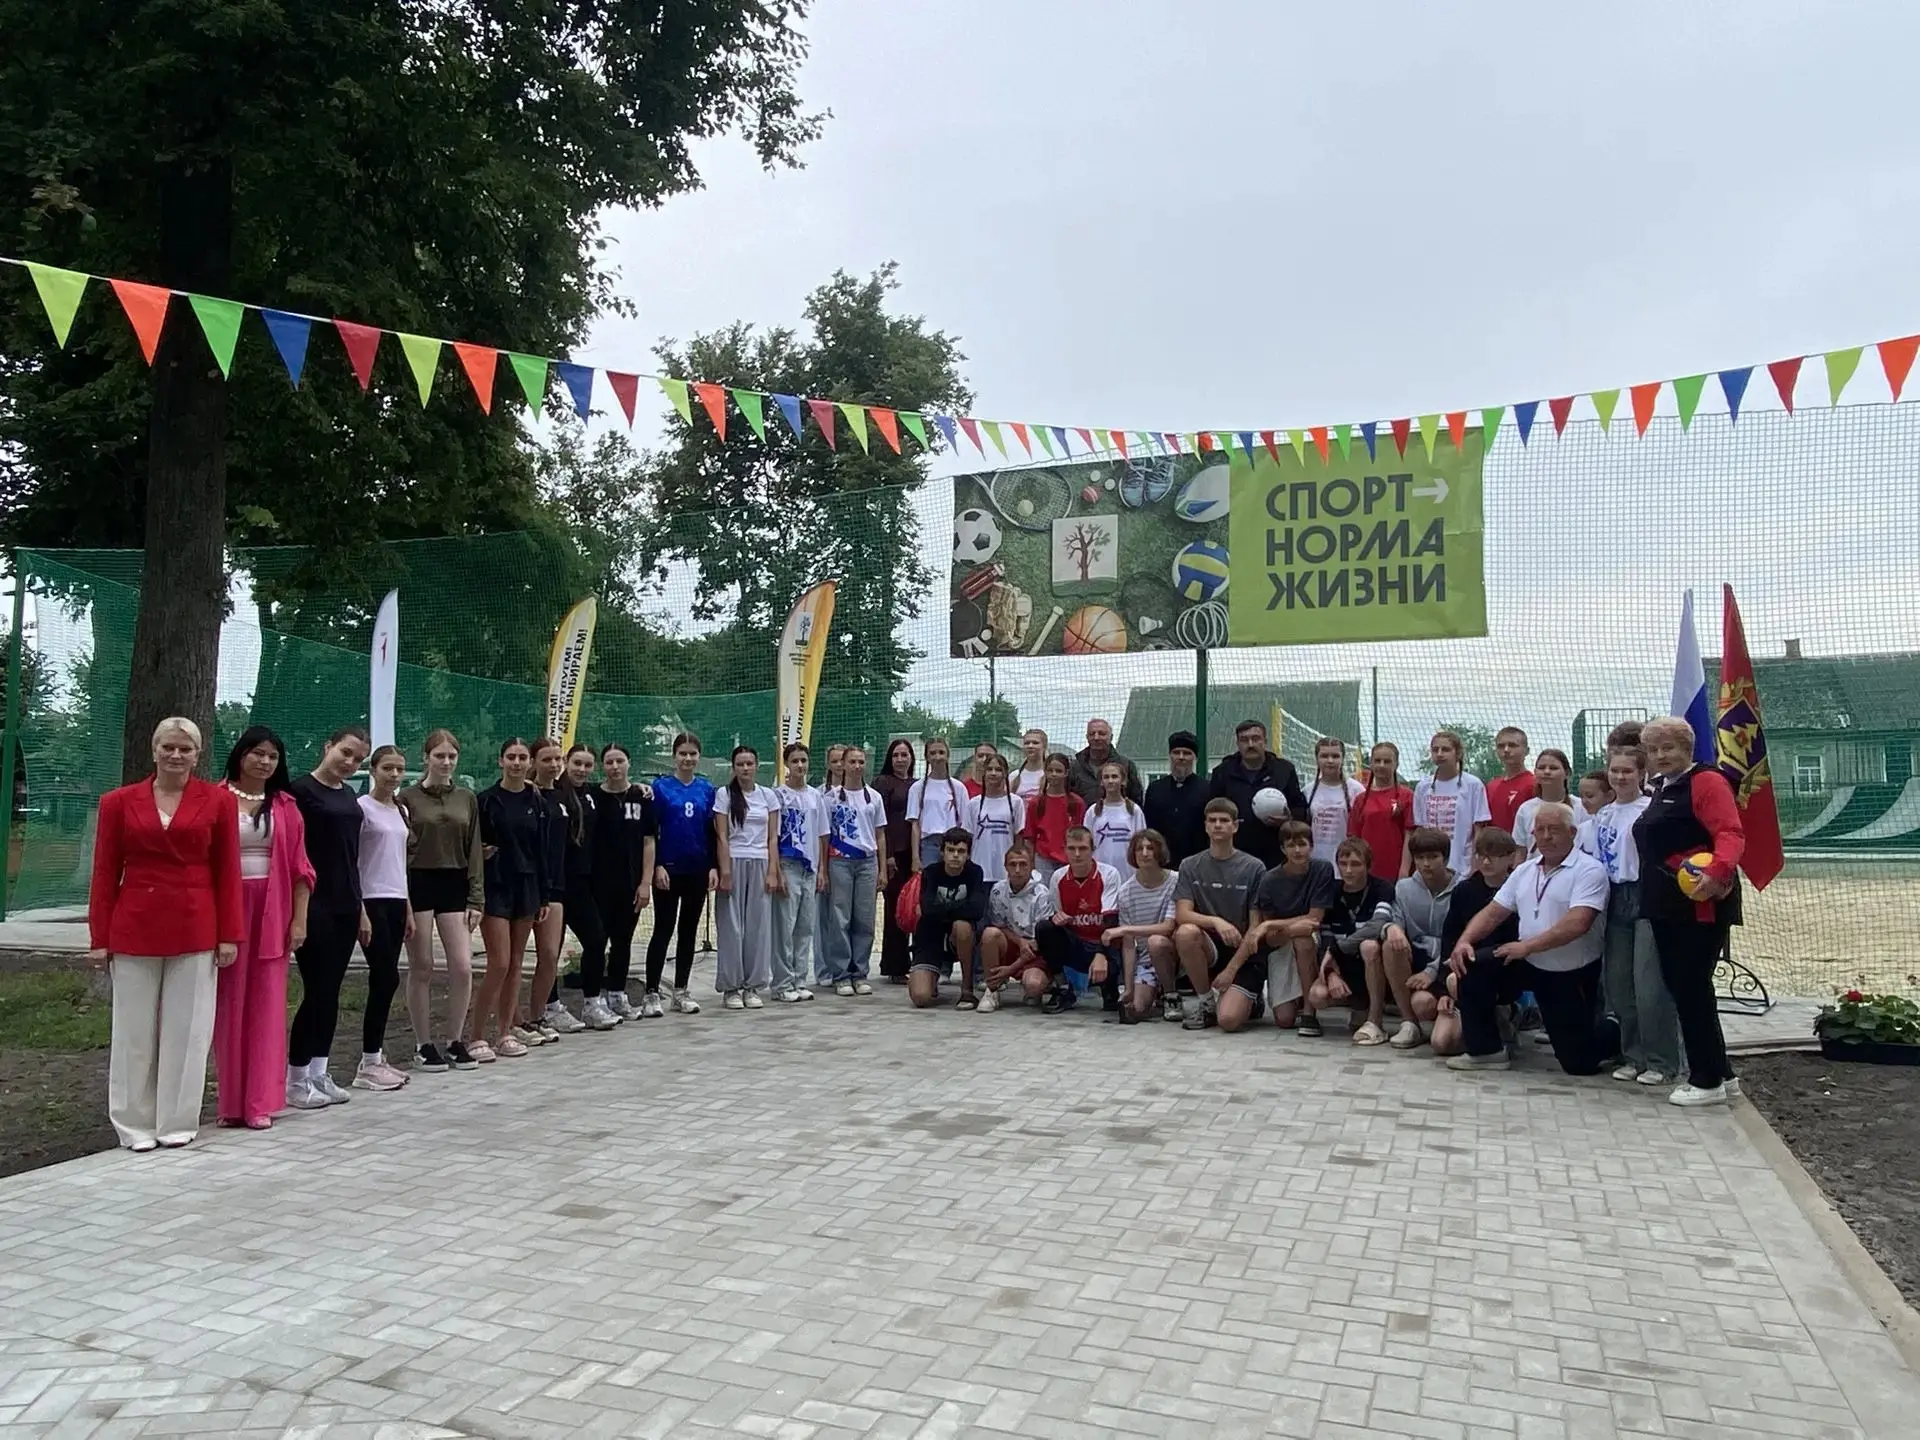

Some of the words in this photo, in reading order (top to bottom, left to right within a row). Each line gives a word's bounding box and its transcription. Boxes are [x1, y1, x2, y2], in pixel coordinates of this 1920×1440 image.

[1266, 473, 1413, 521] СПОРТ
[1266, 517, 1445, 567] НОРМА
[1265, 563, 1446, 610] ЖИЗНИ
[565, 629, 588, 707] ВЫБИРАЕМ!
[550, 694, 559, 737] МАЕМ!
[685, 801, 694, 818] 8
